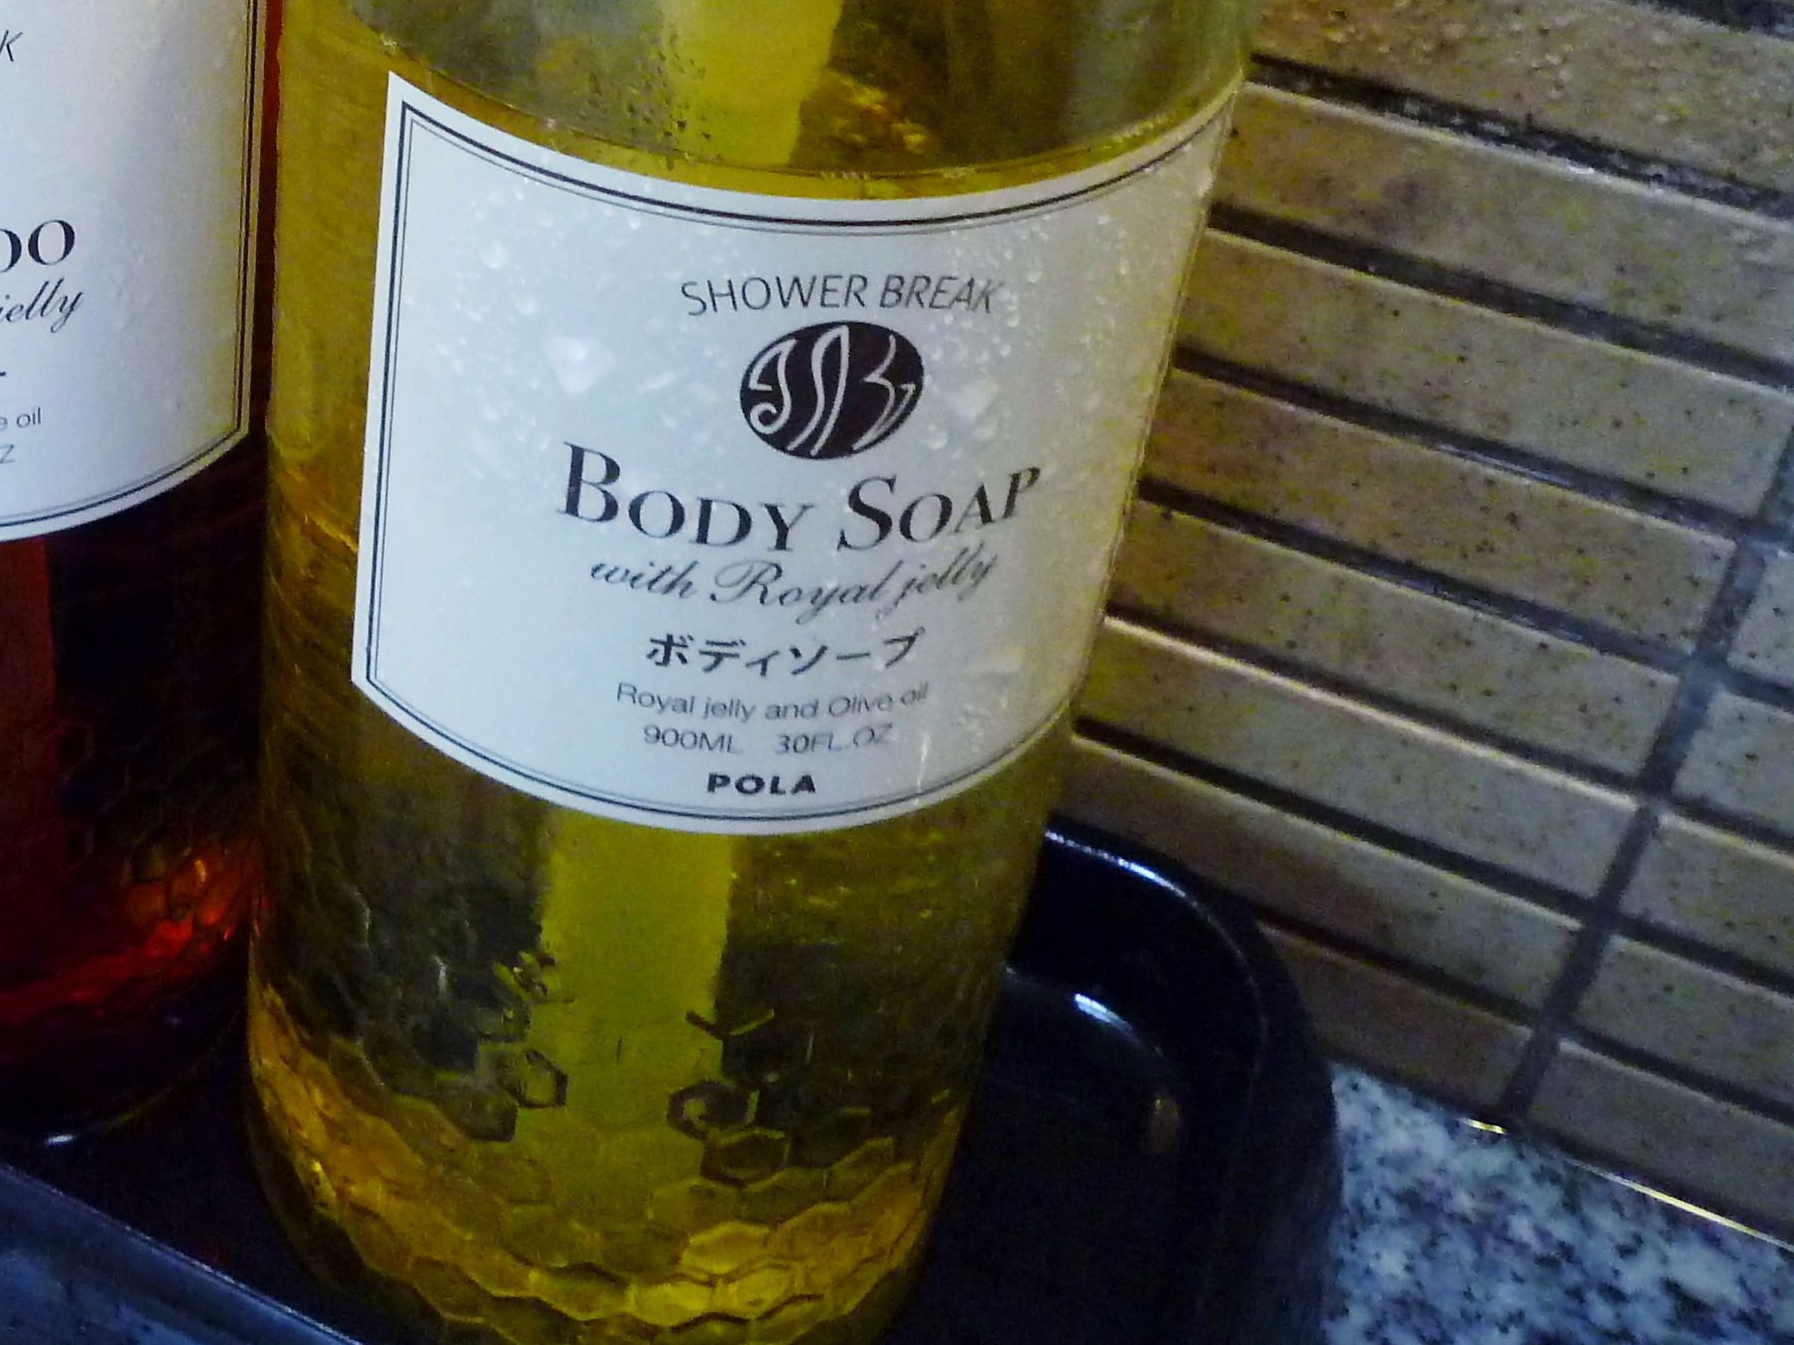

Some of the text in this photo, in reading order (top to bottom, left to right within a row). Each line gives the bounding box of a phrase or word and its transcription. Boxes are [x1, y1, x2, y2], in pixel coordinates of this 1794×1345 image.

[680, 274, 1005, 317] SHOWER BREAK
[16, 406, 43, 429] oil
[589, 542, 1000, 626] with Royal jelly
[645, 625, 927, 679] ボディソープ
[616, 681, 930, 724] Royal jelly and Olive oil
[643, 724, 745, 755] 900ML
[706, 772, 817, 796] POLA
